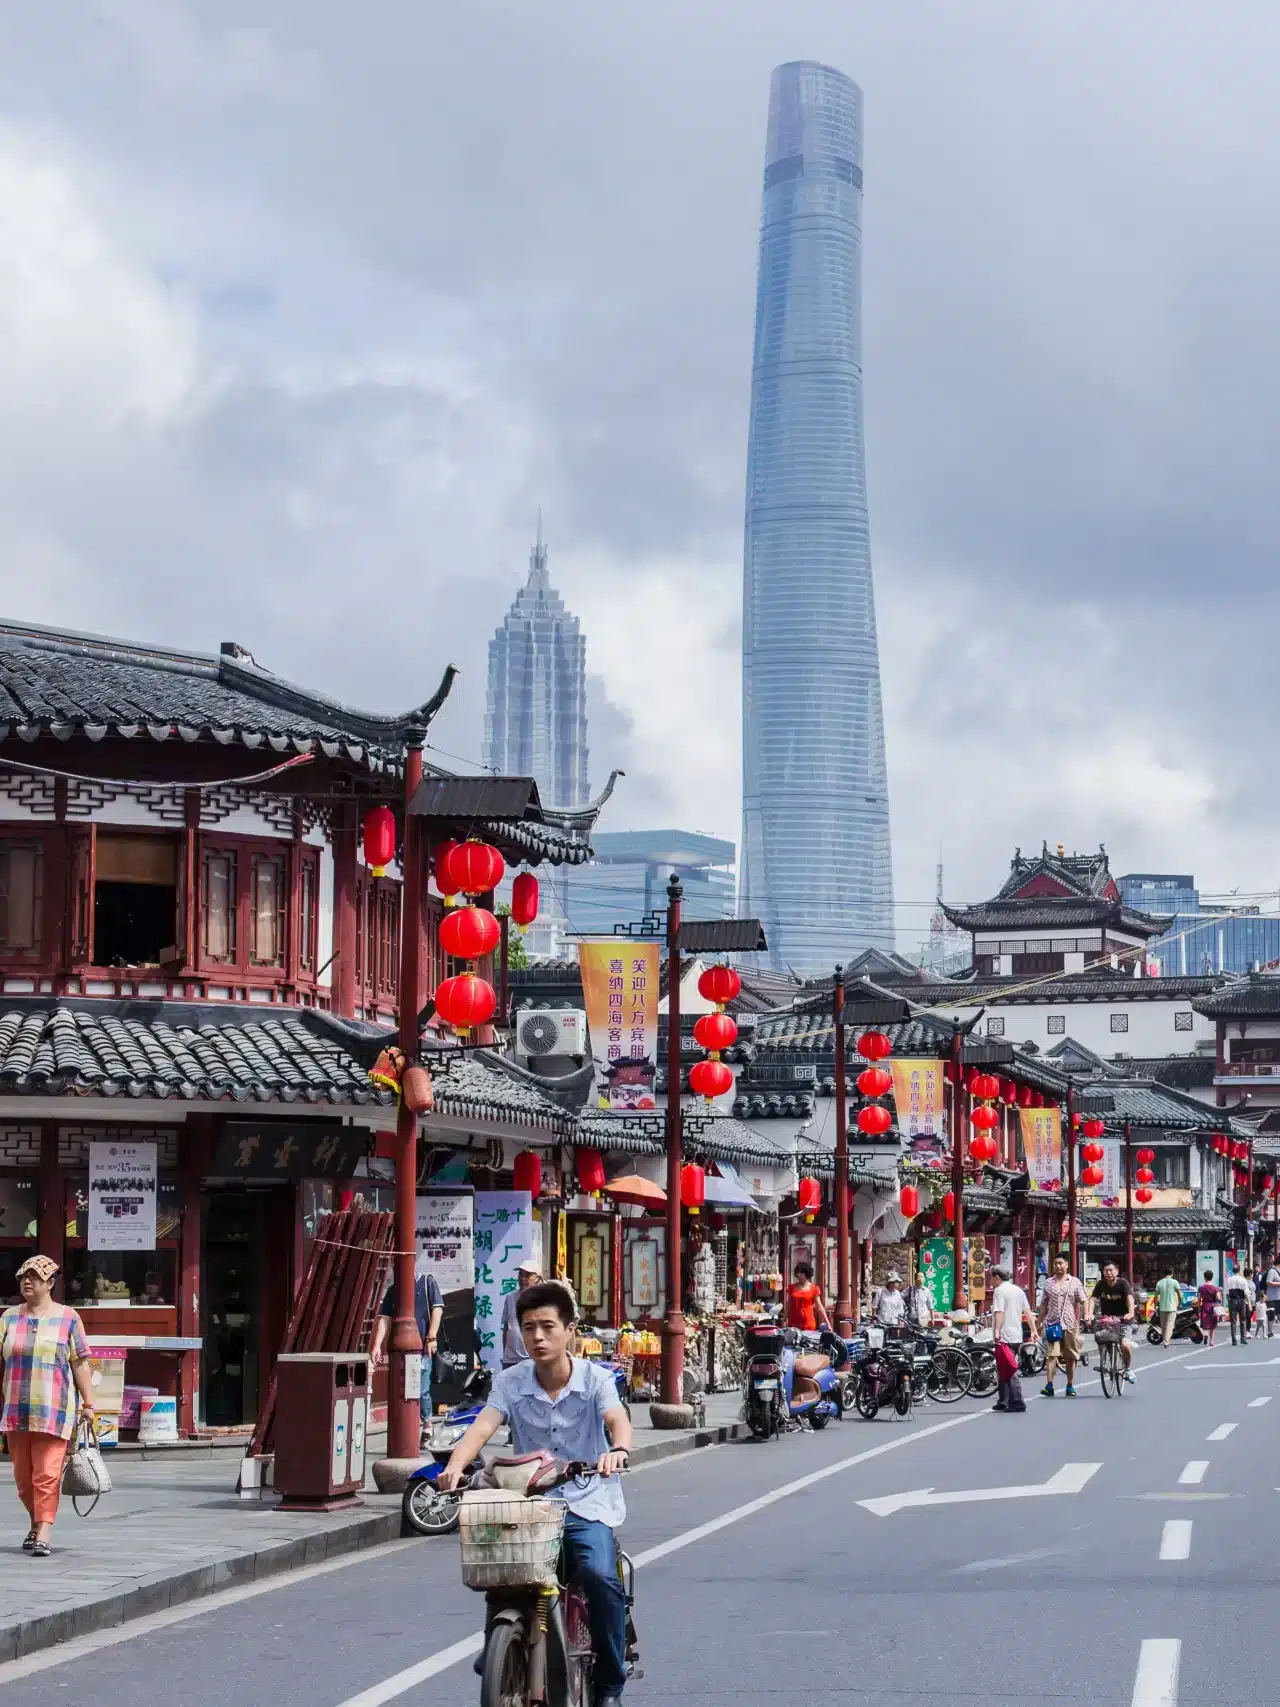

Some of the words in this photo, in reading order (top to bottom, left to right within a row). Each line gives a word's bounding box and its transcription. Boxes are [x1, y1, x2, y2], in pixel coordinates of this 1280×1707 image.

[608, 959, 624, 1059] 喜纳四海客商
[629, 959, 647, 1059] 笑迎八方宾朋
